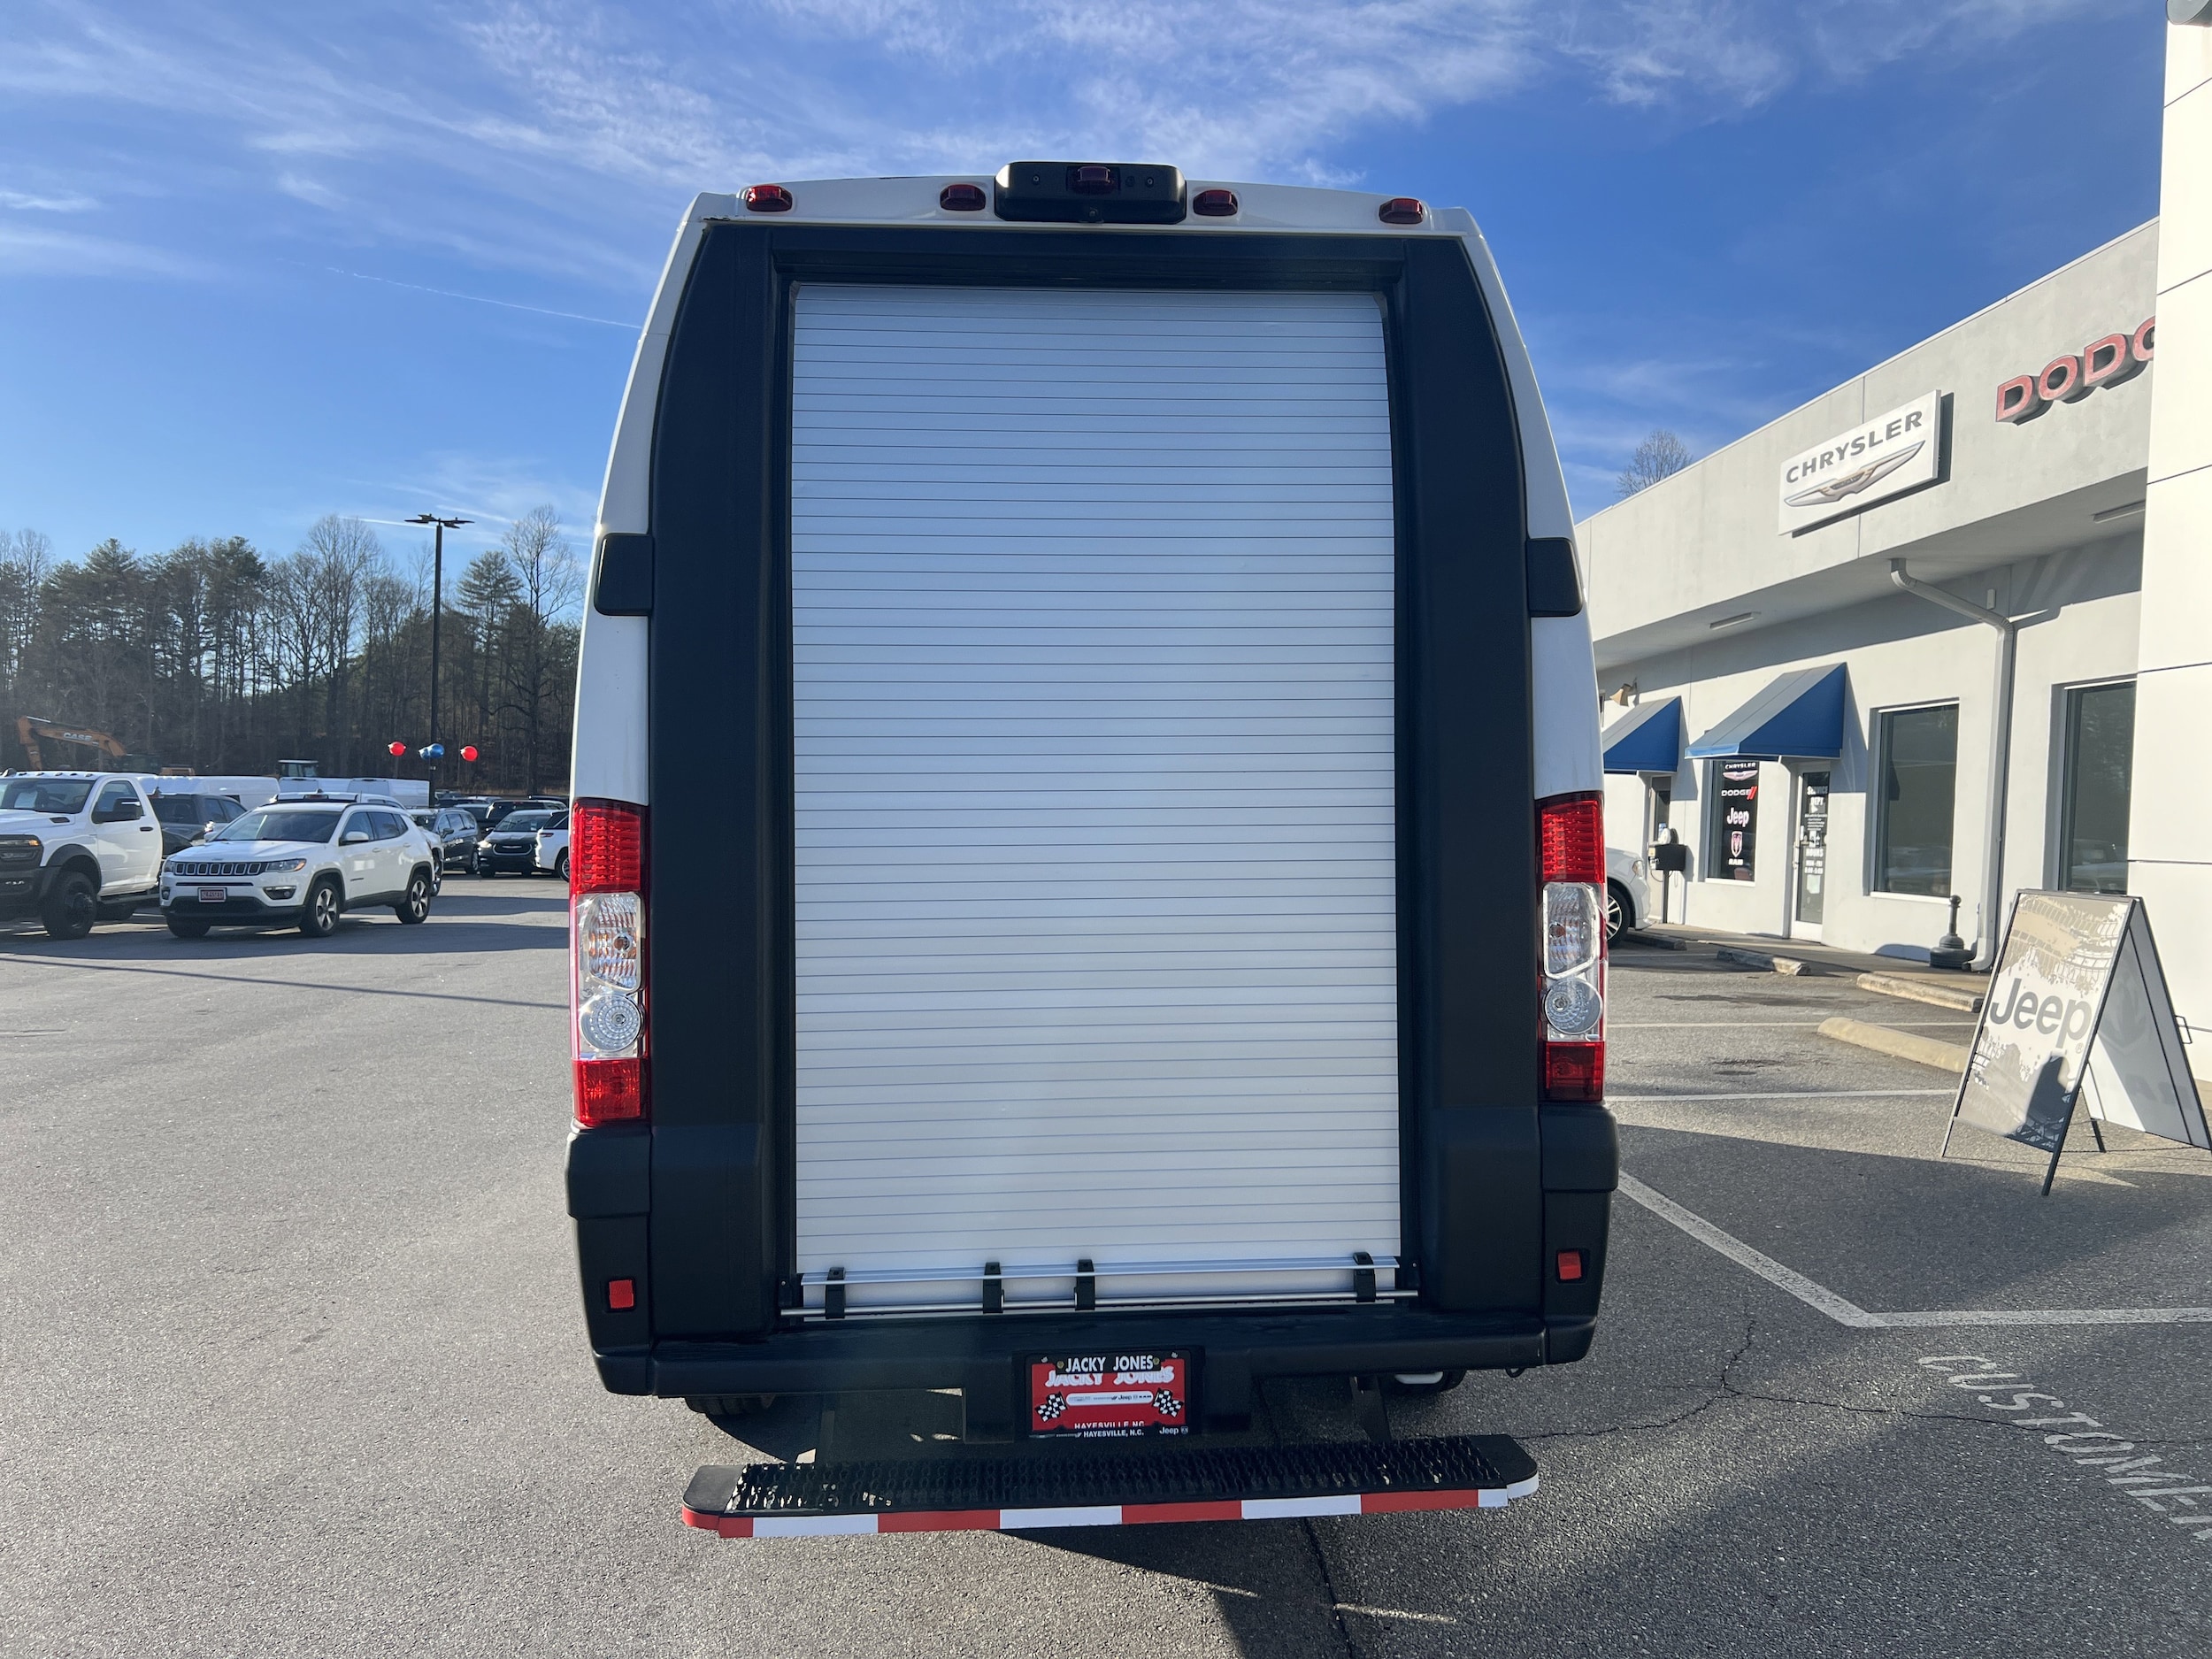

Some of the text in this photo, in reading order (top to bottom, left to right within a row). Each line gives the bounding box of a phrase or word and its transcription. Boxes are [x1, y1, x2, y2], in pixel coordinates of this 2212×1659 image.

[1786, 411, 1923, 483] CHRYSLER
[64, 732, 92, 741] CASE
[1807, 786, 1828, 795] SERVICE
[1726, 807, 1749, 827] Jeep
[1990, 978, 2092, 1048] Jeep
[1065, 1355, 1154, 1372] JACKY JONES
[1045, 1366, 1175, 1387] JACKY JONES
[1083, 1429, 1129, 1438] HAYESVILLE,
[1129, 1428, 1145, 1437] N.C.
[1159, 1426, 1179, 1435] Jeep
